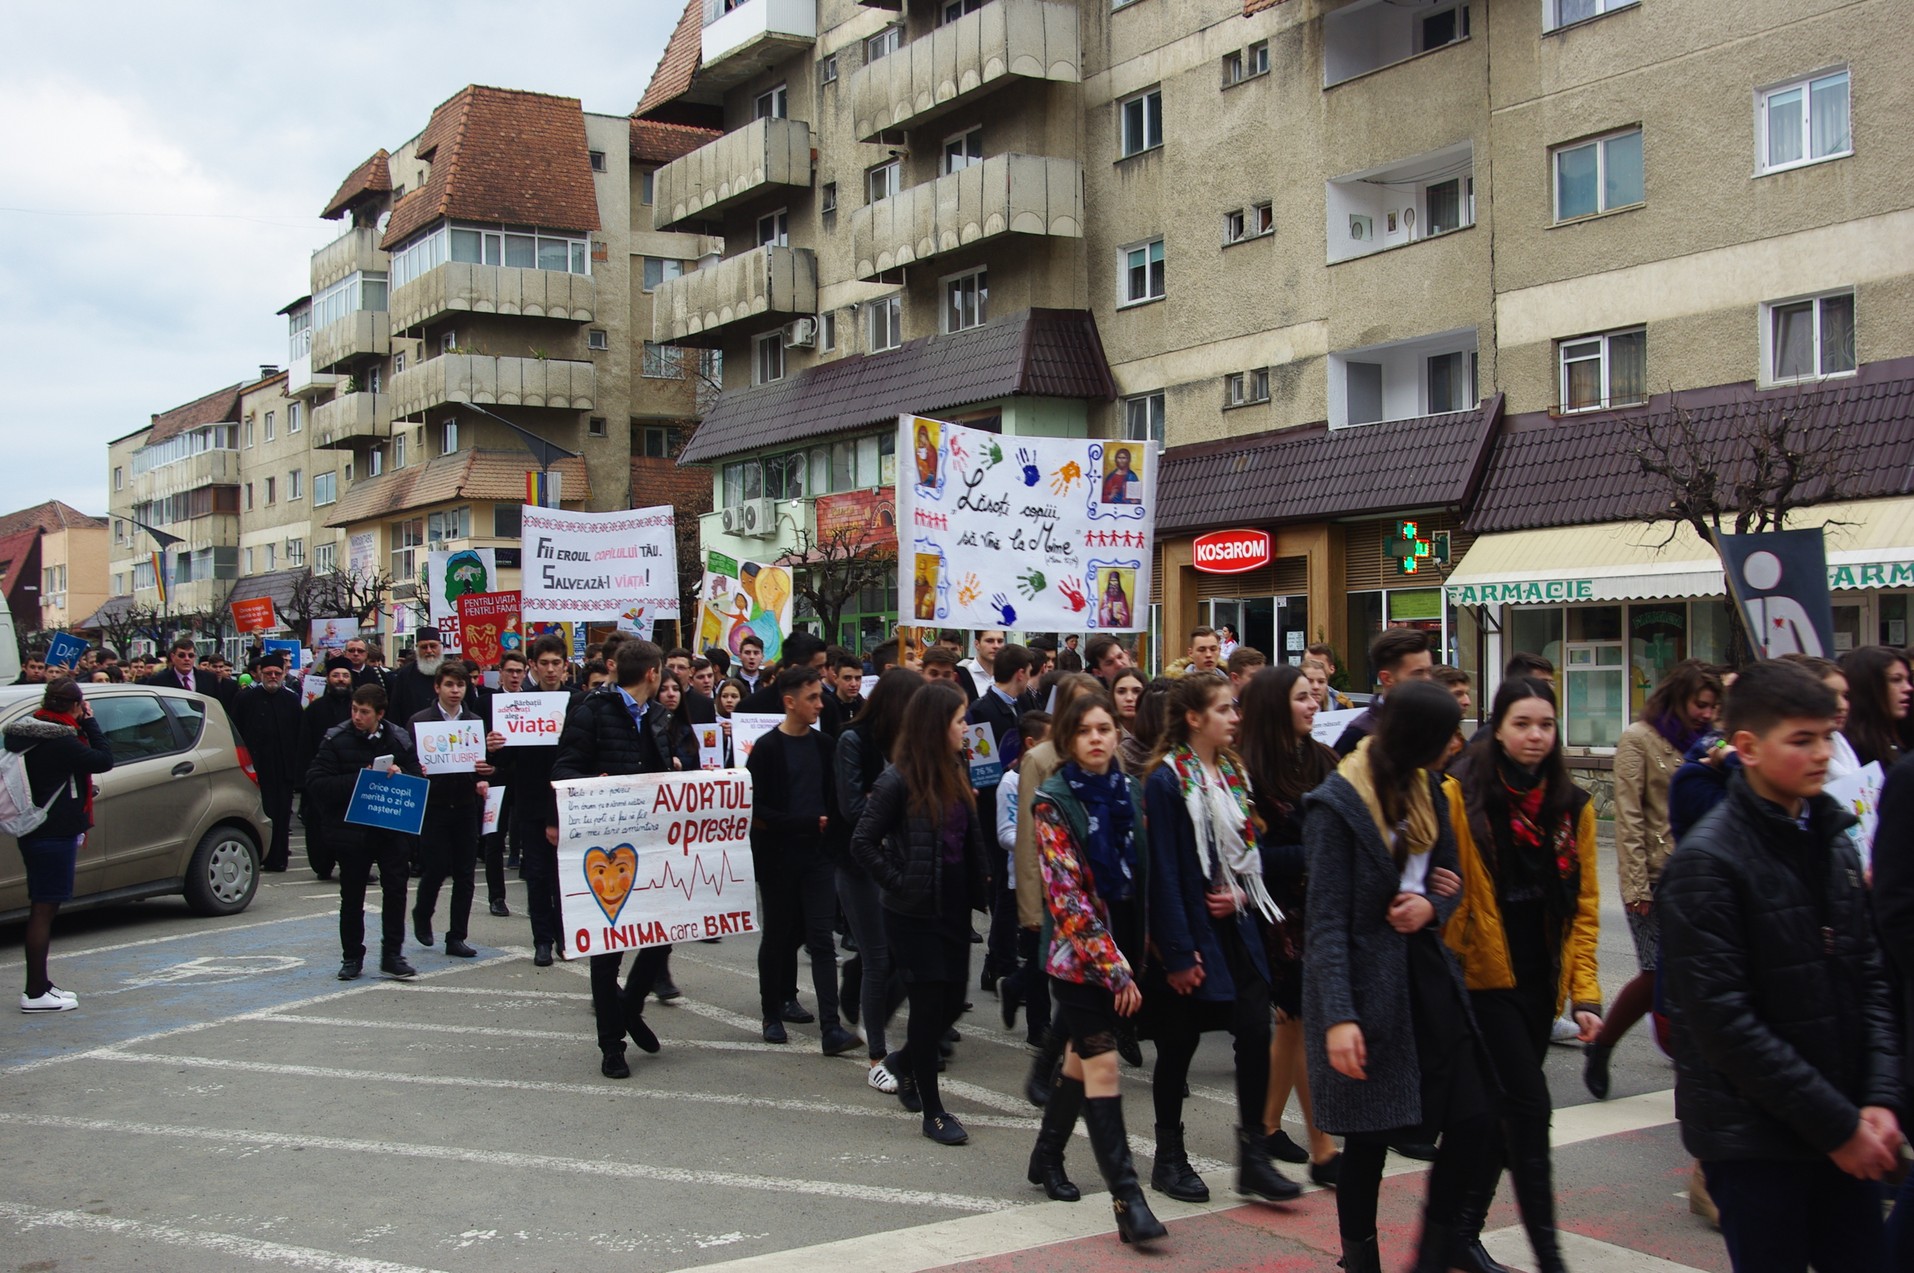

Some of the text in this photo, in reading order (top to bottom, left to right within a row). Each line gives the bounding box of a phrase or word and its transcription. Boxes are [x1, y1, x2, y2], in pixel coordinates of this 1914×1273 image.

[557, 550, 591, 562] EROUL
[1446, 581, 1592, 602] FARMACIE
[464, 597, 494, 608] PENTRU
[465, 606, 494, 616] PENTRU
[507, 716, 556, 736] viața
[424, 752, 479, 765] SUNT IUBIRE
[369, 782, 411, 798] Orice copil
[652, 780, 751, 813] AVORTUL
[361, 793, 385, 802] merită
[404, 799, 416, 808] de
[576, 911, 754, 953] O INIMA care BATE
